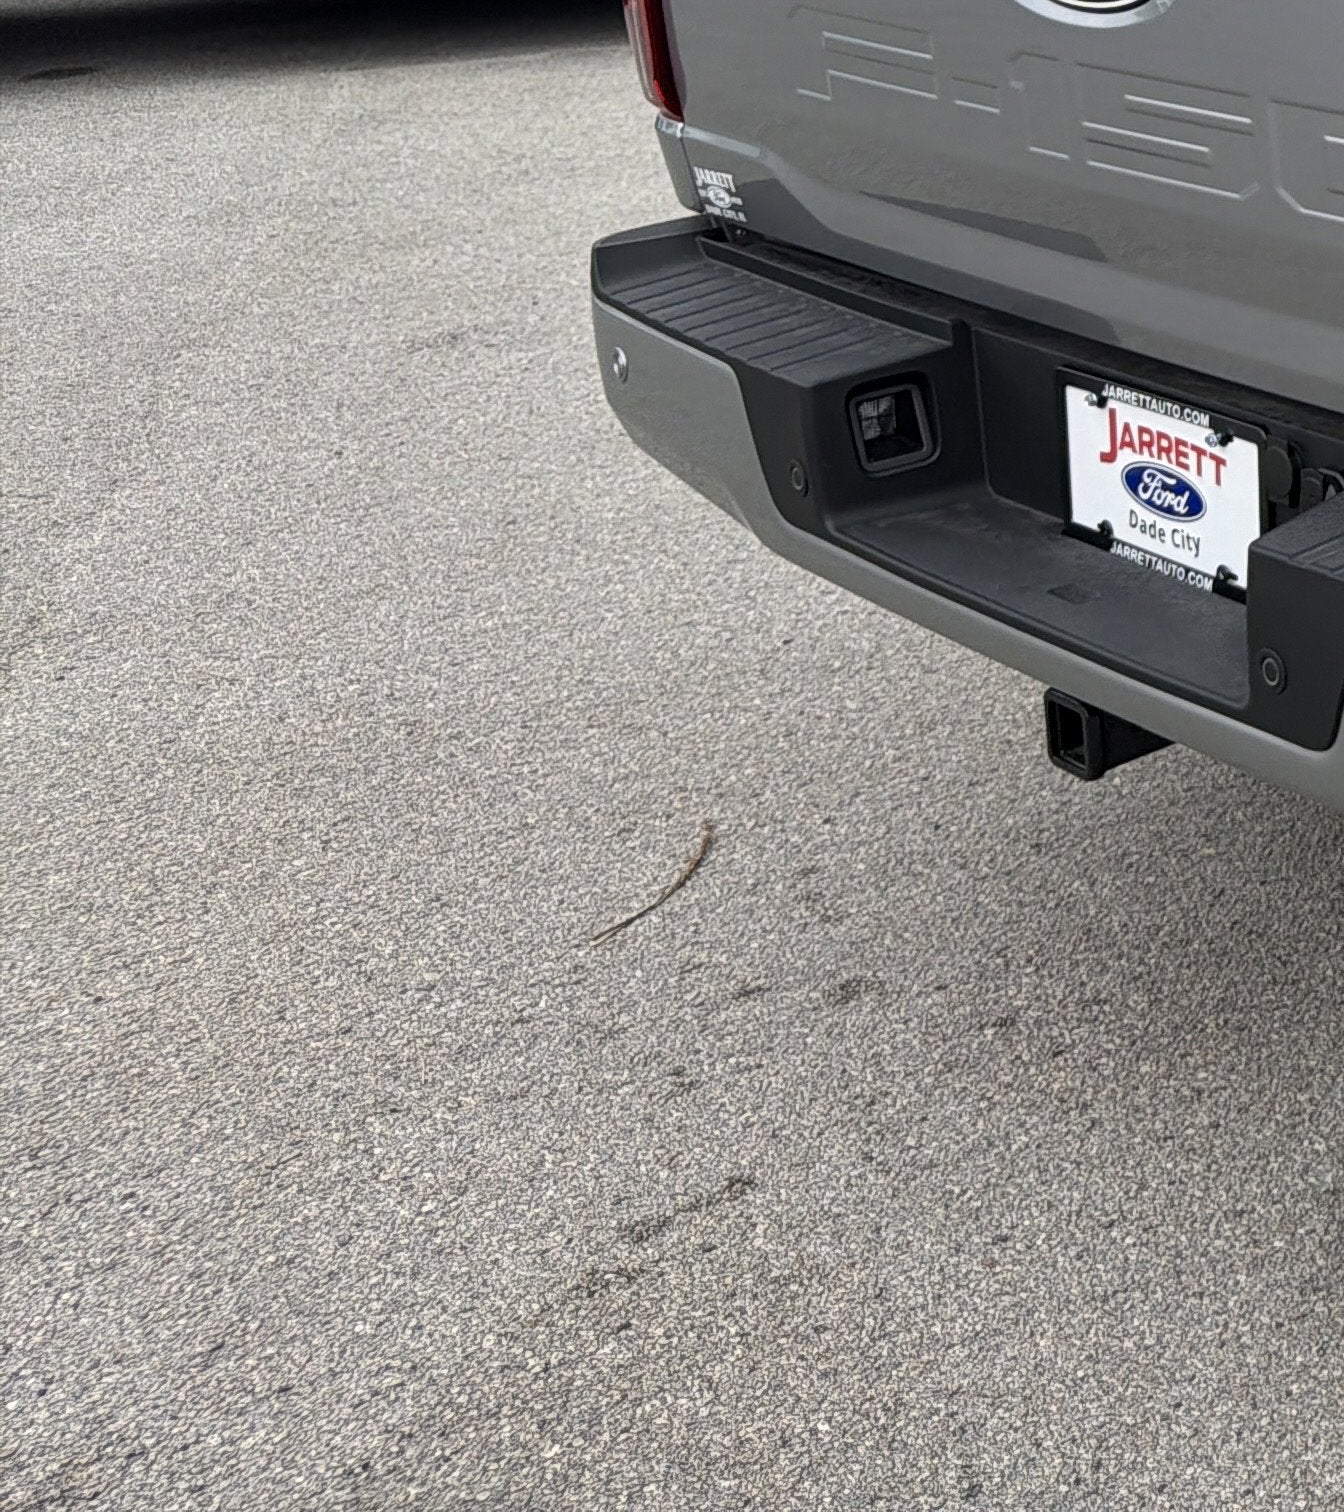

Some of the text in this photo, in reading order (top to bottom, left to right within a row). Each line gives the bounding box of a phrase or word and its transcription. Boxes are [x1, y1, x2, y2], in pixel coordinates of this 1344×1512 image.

[1102, 383, 1210, 427] JARRETTAUTO.COM
[1099, 407, 1227, 487] JARRETT
[1137, 468, 1190, 514] Ford
[1129, 509, 1201, 558] Dade City
[1110, 541, 1213, 592] JARRETTAUTO.COM
